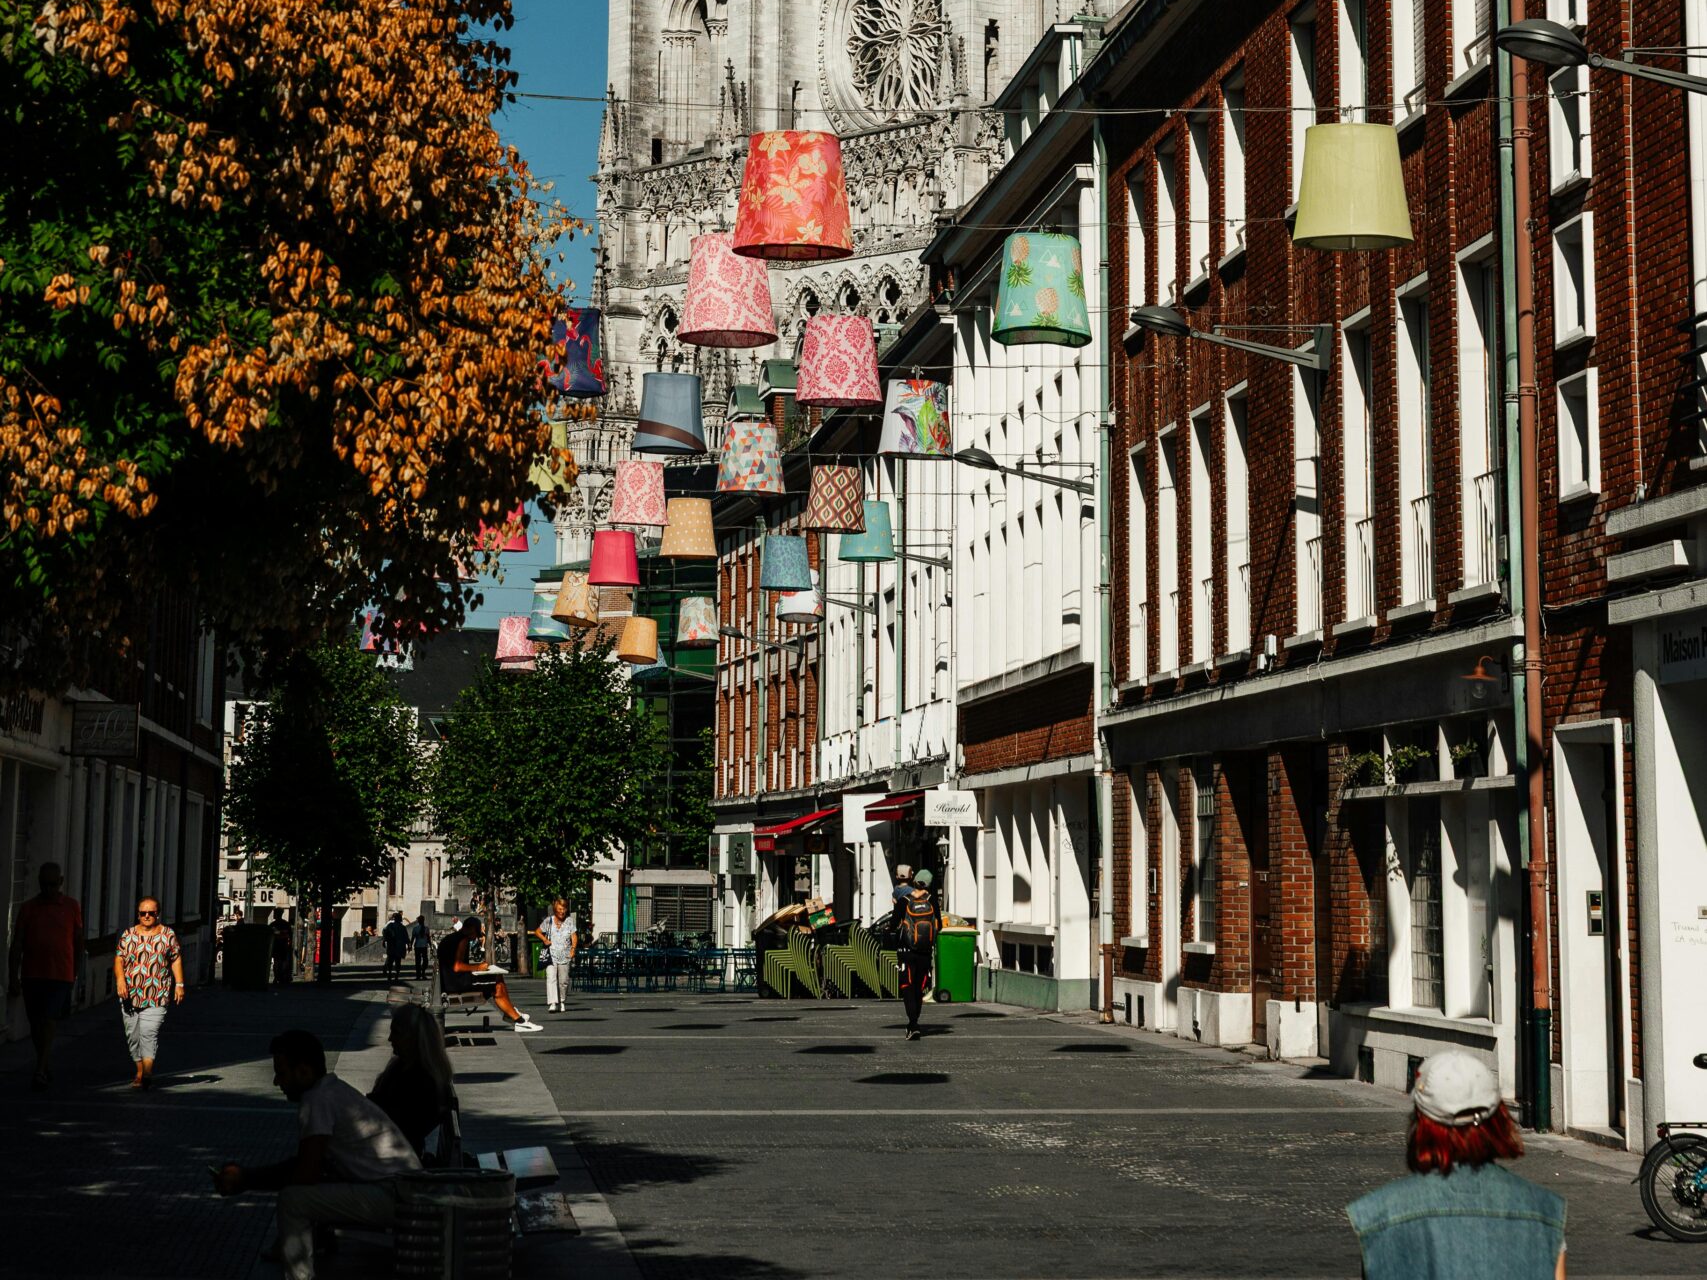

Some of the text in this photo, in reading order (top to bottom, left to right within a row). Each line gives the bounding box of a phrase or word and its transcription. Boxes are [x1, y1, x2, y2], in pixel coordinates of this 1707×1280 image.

[1663, 631, 1700, 664] Maison
[933, 803, 971, 813] Harold
[261, 890, 274, 902] DE
